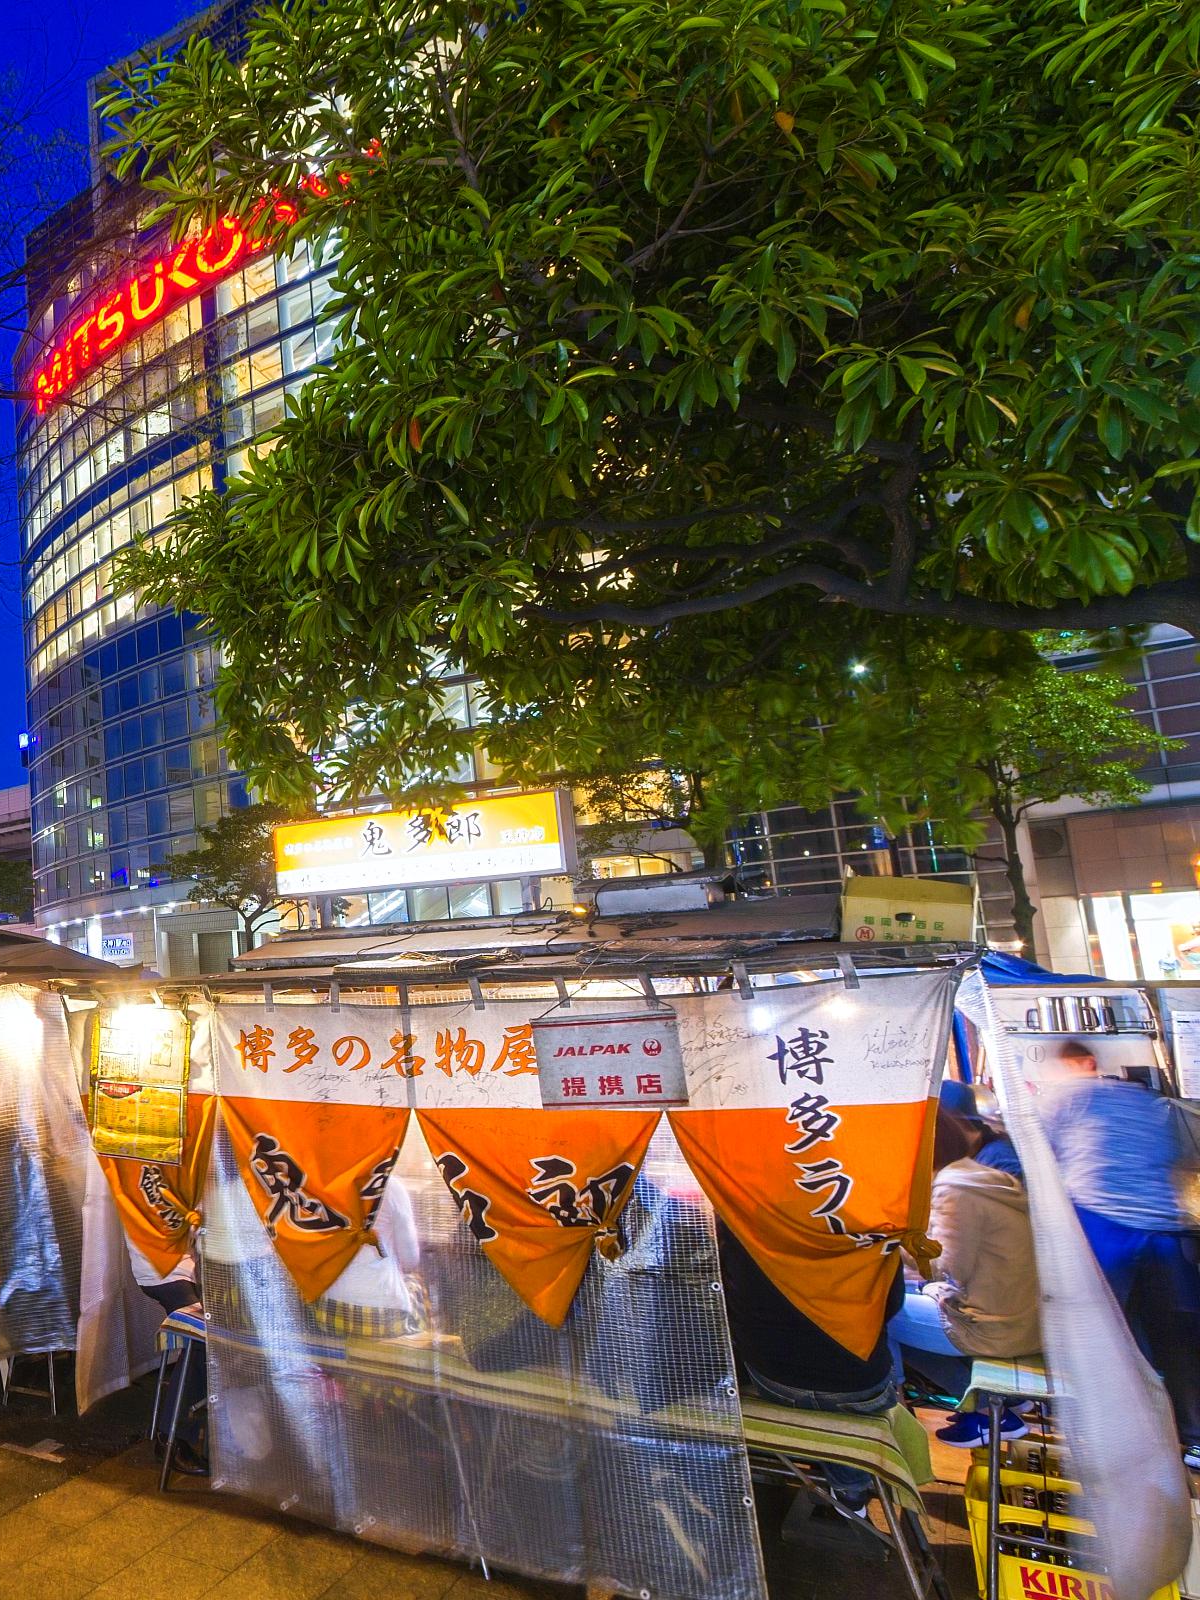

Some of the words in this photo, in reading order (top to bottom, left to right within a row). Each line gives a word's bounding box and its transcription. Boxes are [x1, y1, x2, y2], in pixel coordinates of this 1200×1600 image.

[363, 811, 482, 857] 鬼多郎
[234, 1023, 539, 1078] 博多の名物屋
[552, 1043, 633, 1058] JALPAK
[560, 1073, 663, 1097] 提携店
